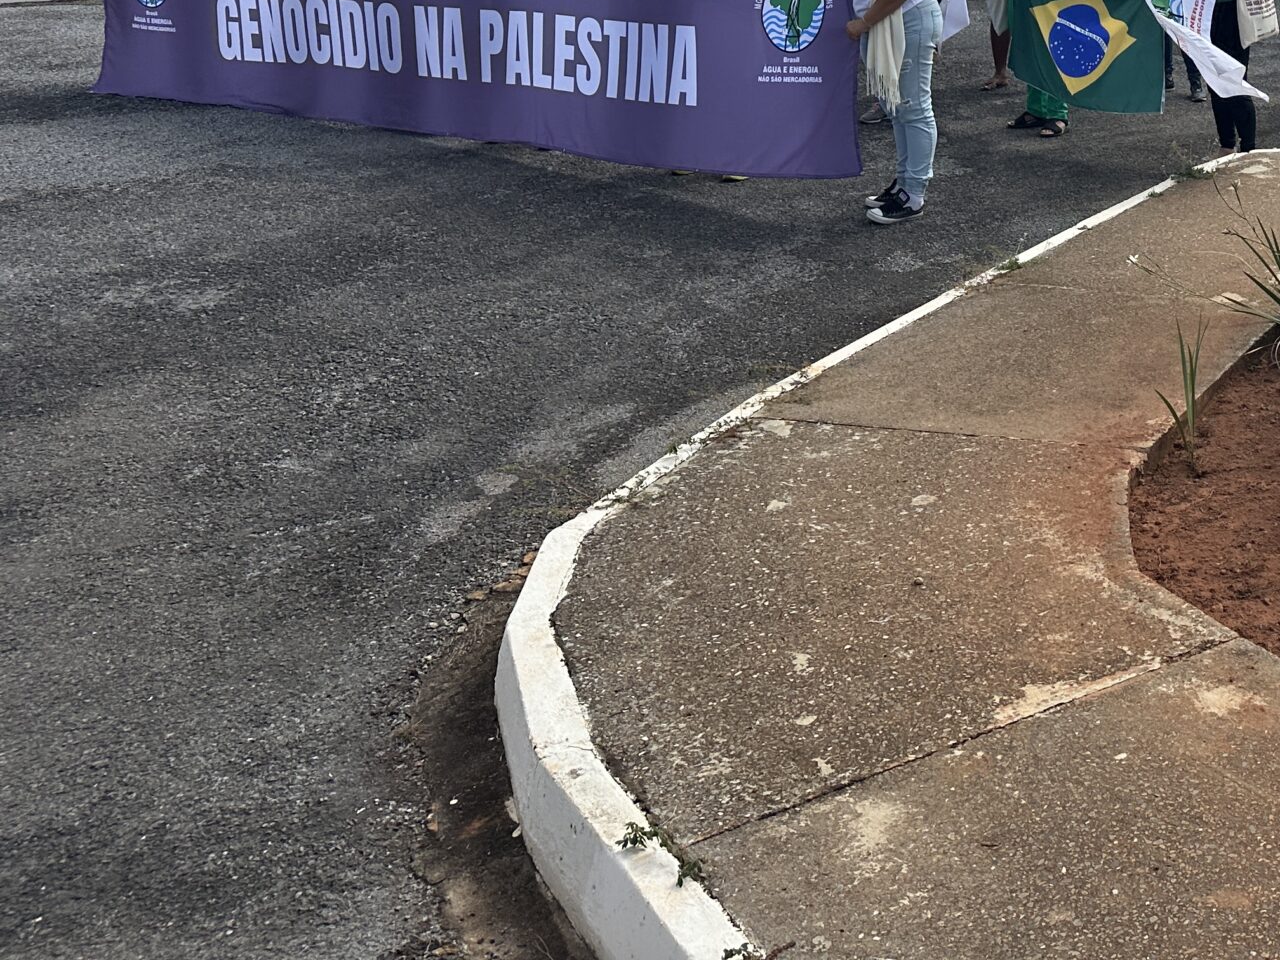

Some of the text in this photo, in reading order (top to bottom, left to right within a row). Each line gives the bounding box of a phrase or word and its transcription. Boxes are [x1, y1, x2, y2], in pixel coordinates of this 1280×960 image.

[413, 5, 468, 81] NA
[479, 9, 698, 107] PALESTINA
[763, 63, 819, 74] ÁGUA E ENERGIA
